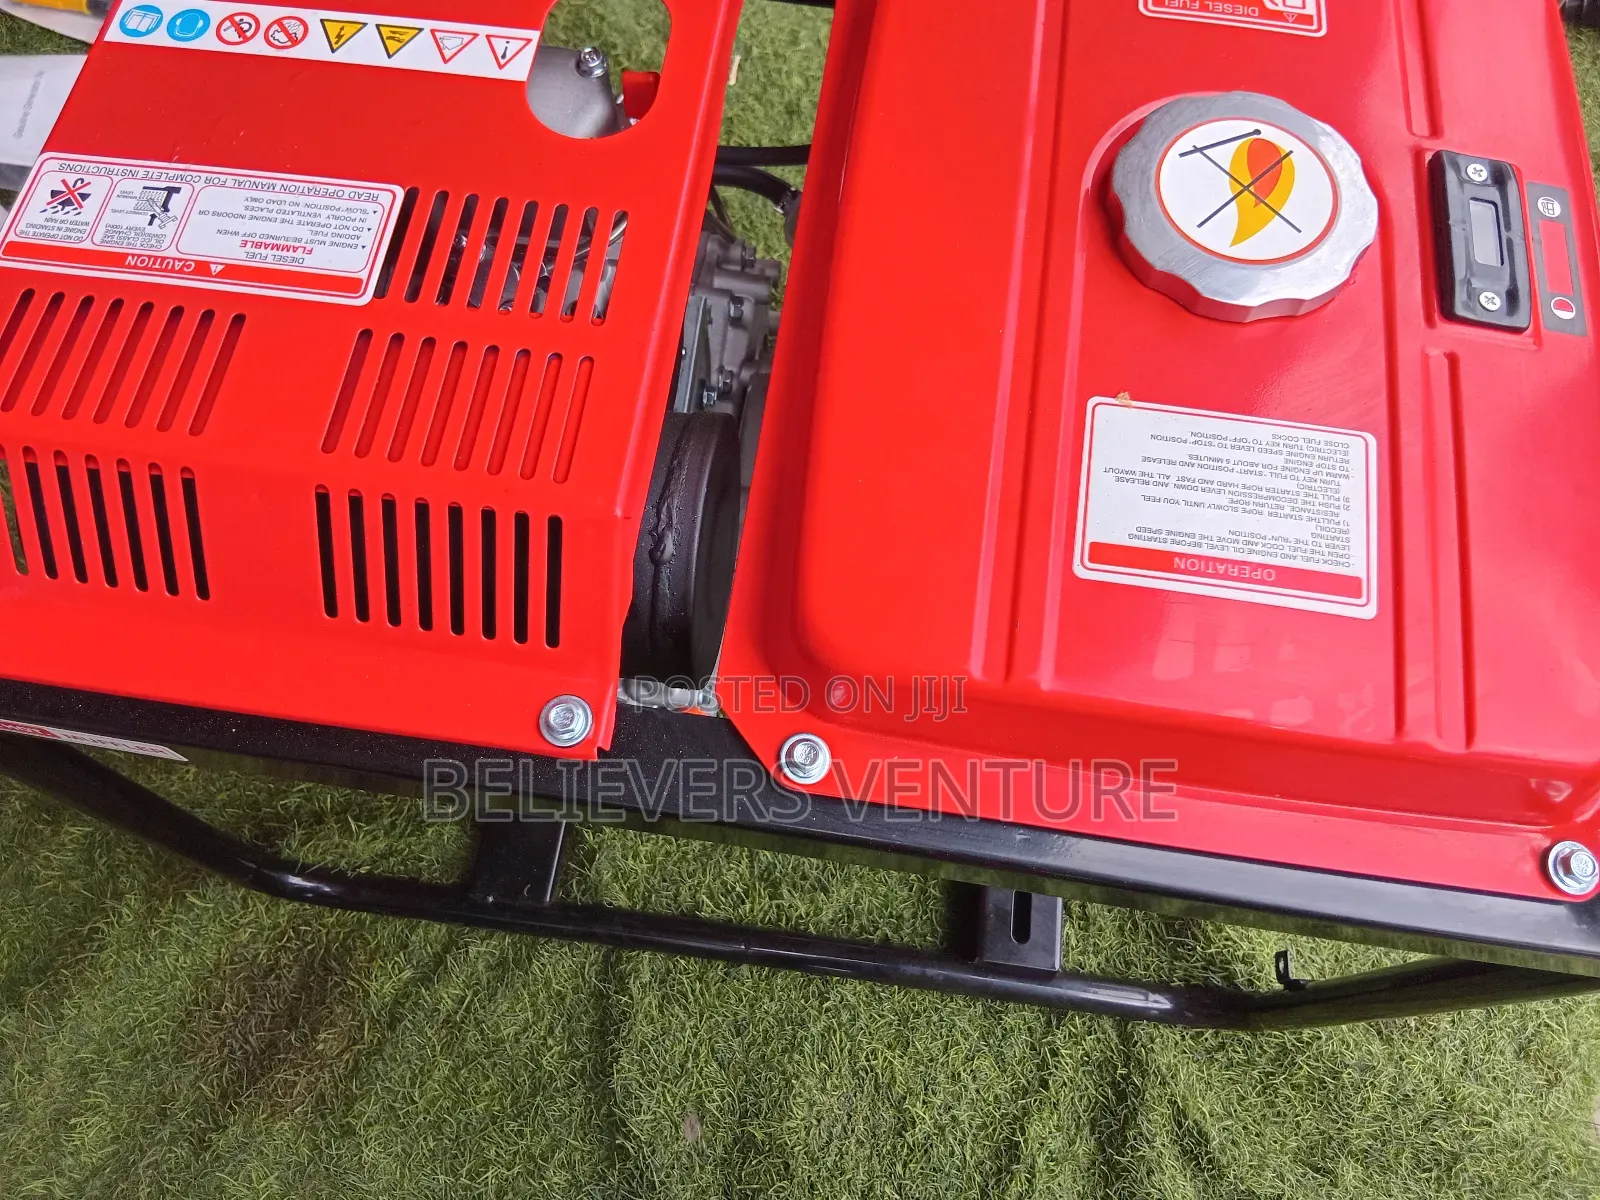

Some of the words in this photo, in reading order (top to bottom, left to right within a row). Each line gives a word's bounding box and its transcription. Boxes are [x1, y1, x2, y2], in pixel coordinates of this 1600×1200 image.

[1204, 1, 1259, 17] DIESEL
[54, 162, 140, 177] INSTRUCTIONS.
[140, 170, 201, 183] COMPLETE
[203, 176, 227, 185] FOR
[229, 178, 277, 190] MANUAL
[278, 183, 345, 197] OPERATION
[347, 190, 379, 201] READ
[210, 210, 246, 219] INDOORS
[275, 208, 322, 218] VENTILATED
[325, 213, 356, 222] POORLY
[247, 214, 277, 222] ENGINE
[24, 222, 56, 230] STANDING
[295, 219, 332, 228] OPERATE
[31, 230, 59, 238] OPERATE
[62, 226, 87, 234] ENGINE
[215, 228, 240, 236] WHEN
[330, 232, 361, 240] ADDING
[303, 237, 326, 245] MUST
[327, 240, 358, 249] ENGINE
[238, 239, 313, 254] FLAMMABLE
[242, 251, 268, 260] FUEL
[269, 254, 304, 264] DIESEL
[124, 254, 196, 272] CAUTION
[1150, 433, 1187, 443] POSITION
[1271, 432, 1298, 442] COCKS
[1300, 436, 1320, 445] FUEL
[1216, 441, 1228, 449] TO
[1229, 443, 1254, 452] LEVER
[1282, 442, 1303, 450] TURN
[1323, 439, 1348, 449] CLOSE
[1256, 446, 1283, 456] SPEED
[1285, 450, 1315, 460] ENGINE
[1305, 445, 1348, 456] (ELECTRIC)
[1140, 455, 1176, 466] RELEASE
[1231, 458, 1259, 468] ABOUT
[1283, 457, 1312, 467] ENGINE
[1317, 454, 1349, 464] RETURN
[1178, 460, 1195, 468] AND
[1196, 462, 1233, 473] POSITION
[1261, 462, 1277, 470] FOR
[1315, 462, 1336, 470] STOP
[1137, 470, 1154, 478] THE
[1280, 465, 1309, 474] ENGINE
[1155, 472, 1170, 480] ALL
[1268, 471, 1287, 479] FULL
[1301, 475, 1316, 483] KEY
[1325, 471, 1349, 479] WARM
[1151, 480, 1168, 488] AND
[1197, 477, 1214, 485] AND
[1216, 480, 1238, 488] HARD
[1319, 478, 1340, 486] TURN
[1200, 486, 1225, 495] LEVER
[1240, 483, 1262, 491] ROPE
[1264, 486, 1300, 496] STARTER
[1296, 482, 1339, 494] (ELECTRIC)
[1140, 494, 1160, 502] FEEL
[1227, 489, 1297, 504] DECOMPRESSION
[1301, 491, 1318, 499] THE
[1320, 493, 1340, 501] PULL
[1162, 497, 1179, 505] YOU
[1181, 499, 1204, 508] UNTIL
[1252, 500, 1284, 510] RETURN
[1318, 501, 1340, 510] PUSH
[1206, 502, 1238, 512] SLOWLY
[1240, 507, 1262, 515] ROPE
[1267, 510, 1302, 521] STARTER
[1135, 525, 1162, 535] SPEED
[1164, 529, 1195, 539] ENGINE
[1315, 524, 1349, 535] (RECOIL)
[1127, 532, 1167, 544] STARTING
[1197, 533, 1213, 541] THE
[1228, 529, 1266, 540] POSITION
[1310, 531, 1349, 543] STARTING
[1169, 538, 1202, 548] BEFORE
[1215, 536, 1239, 545] MOVE
[1241, 539, 1259, 547] AND
[1204, 542, 1228, 552] LEVEL
[1231, 546, 1244, 554] OIL
[1260, 542, 1284, 551] COCK
[1287, 545, 1306, 553] FUEL
[1324, 542, 1349, 551] LEVER
[1246, 548, 1277, 558] ENGINE
[1279, 552, 1297, 561] AND
[1308, 548, 1325, 556] THE
[1327, 550, 1349, 559] OPEN
[1300, 555, 1319, 563] FUEL
[1321, 558, 1350, 567] CHECK
[1172, 556, 1275, 581] OPERATION
